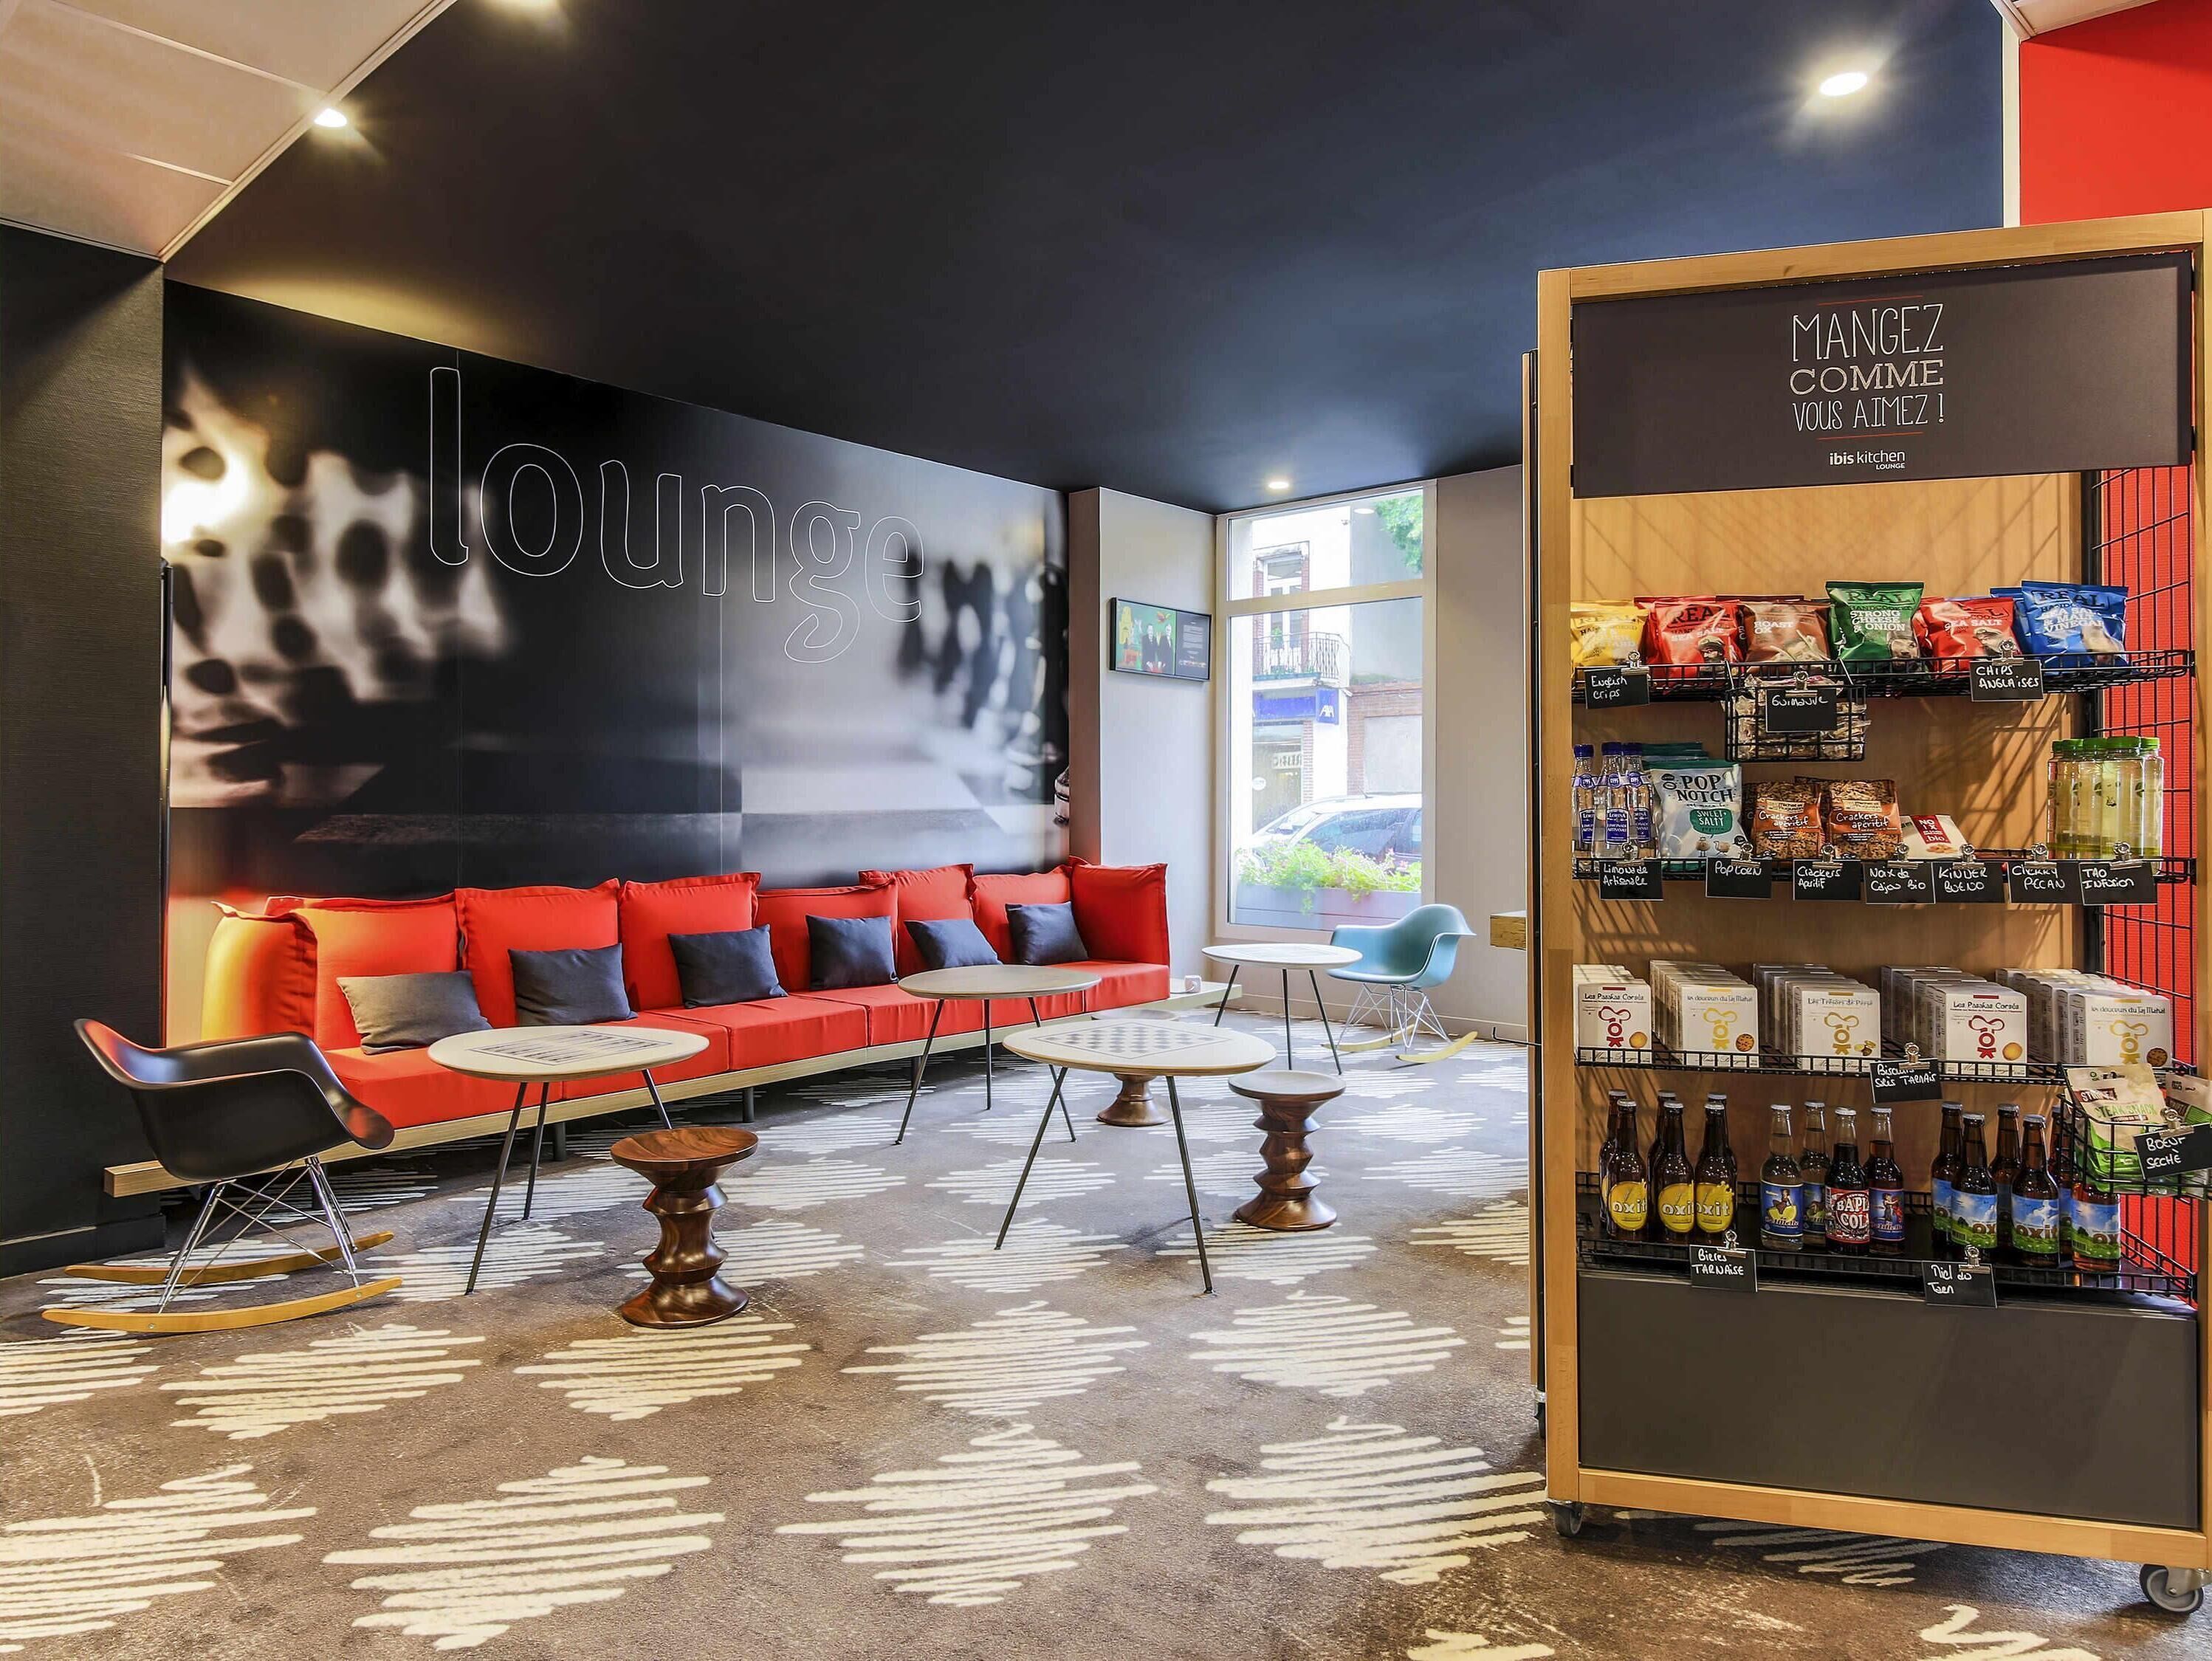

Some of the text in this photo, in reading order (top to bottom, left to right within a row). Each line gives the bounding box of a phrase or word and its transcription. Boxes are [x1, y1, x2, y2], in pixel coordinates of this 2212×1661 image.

[1792, 303, 1944, 362] MANGEZ
[1790, 359, 1944, 395] COMME
[1792, 393, 1945, 431] VOUS AIMEZ !
[1829, 450, 1906, 465] ibis kitchen
[1875, 462, 1906, 470] LOUNGE
[430, 366, 924, 663] lounge
[1849, 610, 1901, 619] STRONG
[1851, 617, 1900, 625] CHEESE
[1945, 620, 1969, 631] SEA
[1864, 623, 1906, 631] ONION
[1976, 665, 2014, 676] CHIPS
[1680, 774, 1721, 790] POP
[1675, 788, 1734, 802] NOTCH
[1759, 811, 1799, 820] Crackers
[1835, 812, 1878, 822] Crackers
[1699, 817, 1724, 826] SALTY
[1797, 866, 1841, 878] Crackers
[2082, 868, 2107, 878] TAO
[2024, 878, 2065, 890] PECAN
